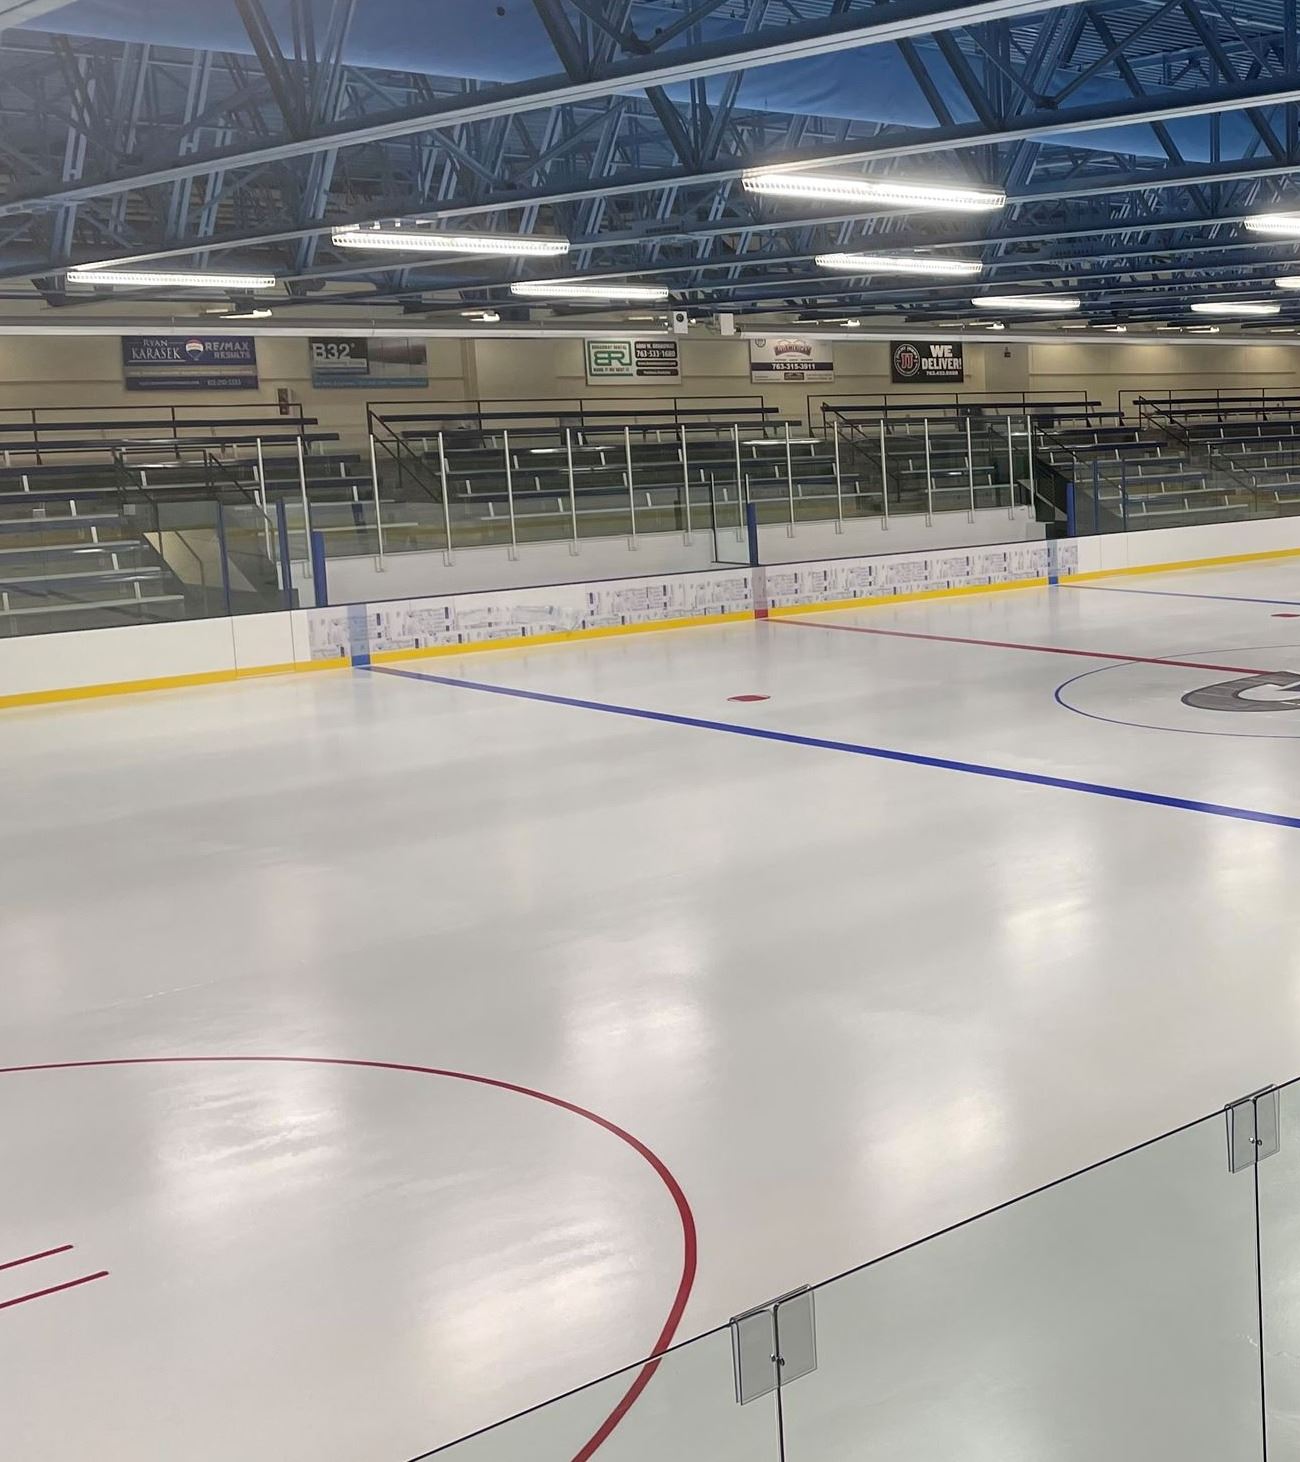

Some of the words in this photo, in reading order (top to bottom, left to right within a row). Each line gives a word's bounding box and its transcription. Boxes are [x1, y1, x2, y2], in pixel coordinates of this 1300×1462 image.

[205, 341, 249, 351] RE/MAX
[929, 345, 953, 357] WE
[131, 347, 181, 360] KARASEK
[214, 351, 251, 359] RESULTS
[921, 357, 962, 370] DELIVER!
